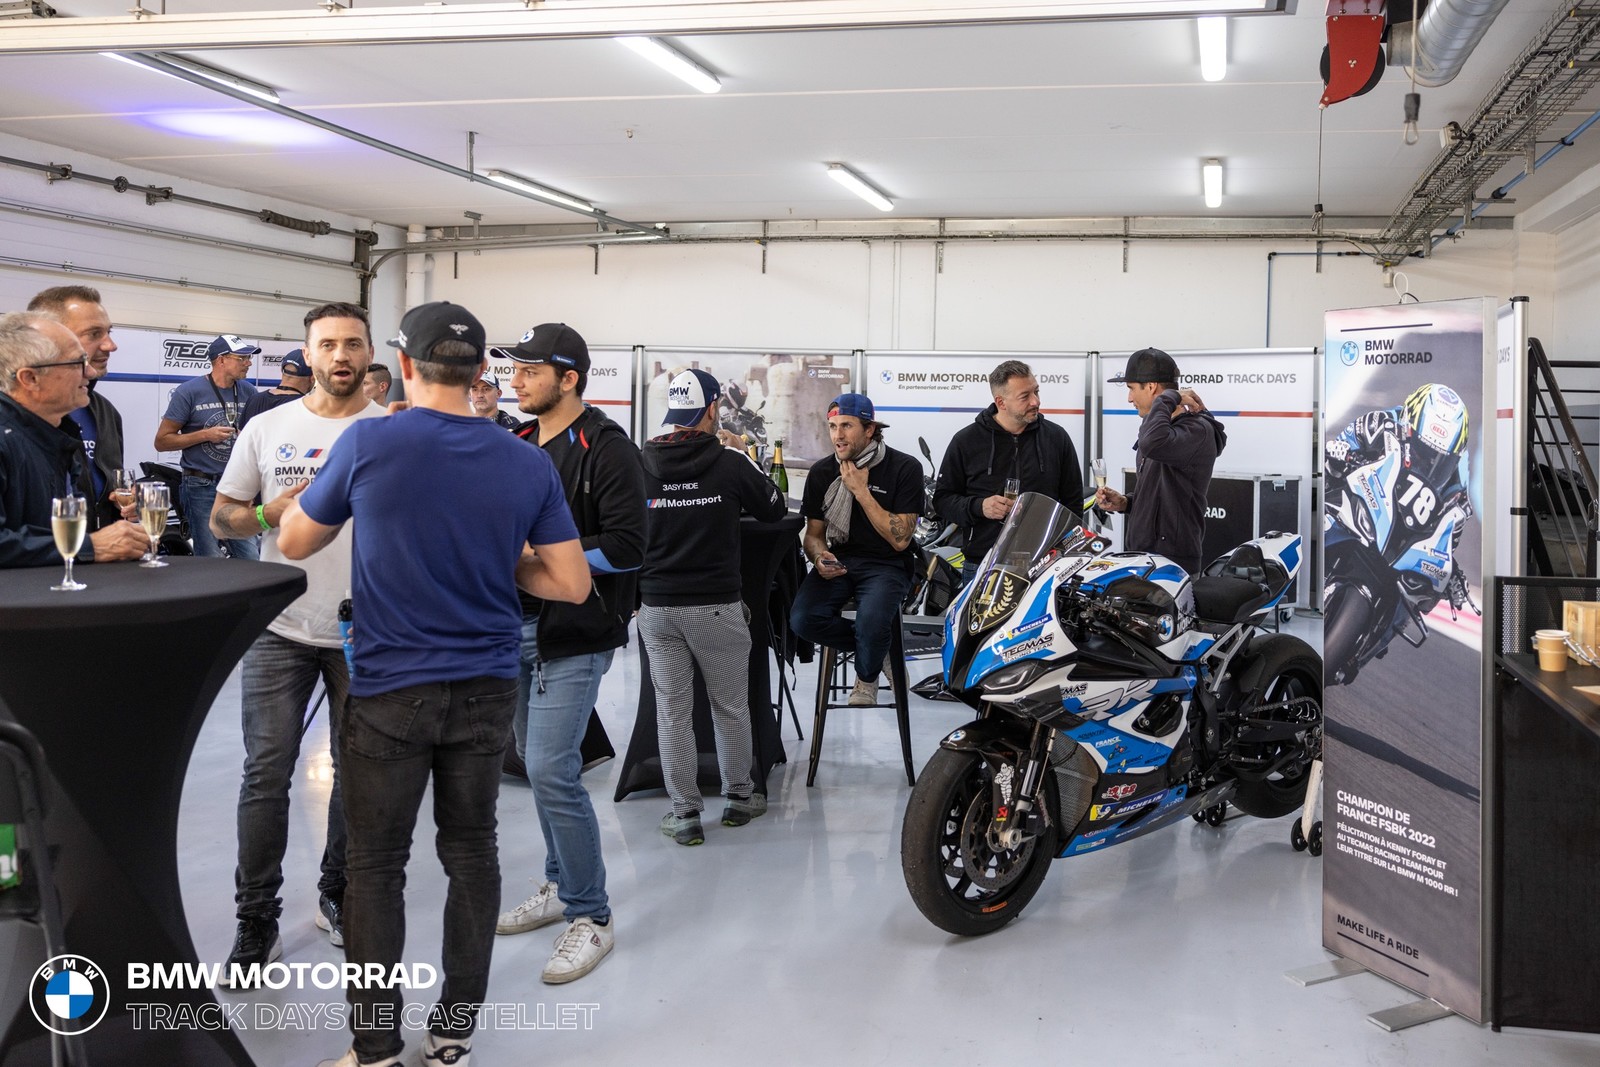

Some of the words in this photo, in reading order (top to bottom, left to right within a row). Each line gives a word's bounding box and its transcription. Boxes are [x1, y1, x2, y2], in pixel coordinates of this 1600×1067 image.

[1365, 339, 1394, 351] BMW
[164, 361, 212, 369] RACING
[1365, 352, 1433, 365] MOTORRAD
[591, 368, 618, 377] DAYS
[898, 373, 927, 382] BMW
[931, 373, 990, 383] MOTORRA
[1040, 374, 1070, 384] DAYS
[1180, 374, 1224, 384] TORRAD
[1227, 374, 1265, 384] TRACK
[1266, 373, 1297, 384] DAYS
[669, 386, 690, 397] BMW
[275, 466, 306, 476] BMW
[682, 482, 699, 490] RIDE
[667, 494, 722, 508] Motorsport
[1398, 474, 1436, 525] 18
[1019, 616, 1049, 632] MICHELIN
[1003, 633, 1054, 658] TECMAS
[1116, 793, 1164, 814] MICHELIN
[1336, 790, 1394, 819] CHAMPION
[1395, 809, 1411, 825] DE
[1337, 803, 1378, 827] FRANCE
[1378, 818, 1407, 838] FSBK
[1408, 828, 1436, 848] 2022
[1336, 821, 1380, 844] FÉLICITATION
[1380, 836, 1386, 847] À
[1386, 840, 1412, 856] KENNY
[1411, 850, 1437, 866] FORAY
[1436, 860, 1447, 870] ET
[1336, 832, 1347, 842] AU
[1347, 836, 1374, 853] TECMAS
[1374, 846, 1401, 863] RACING
[1401, 857, 1422, 871] TEAM
[1422, 866, 1444, 880] POUR
[1336, 842, 1354, 855] LEUR
[1353, 849, 1373, 863] TITRE
[1373, 857, 1387, 869] SUR
[1387, 862, 1397, 872] LA
[1396, 867, 1416, 880] BMW
[1416, 874, 1424, 883] M
[1424, 877, 1444, 891] 1000
[1443, 884, 1455, 896] RR
[1337, 914, 1364, 934] MAKE
[1365, 927, 1385, 944] LIFE
[1386, 937, 1394, 948] A
[1396, 941, 1419, 959] RIDE
